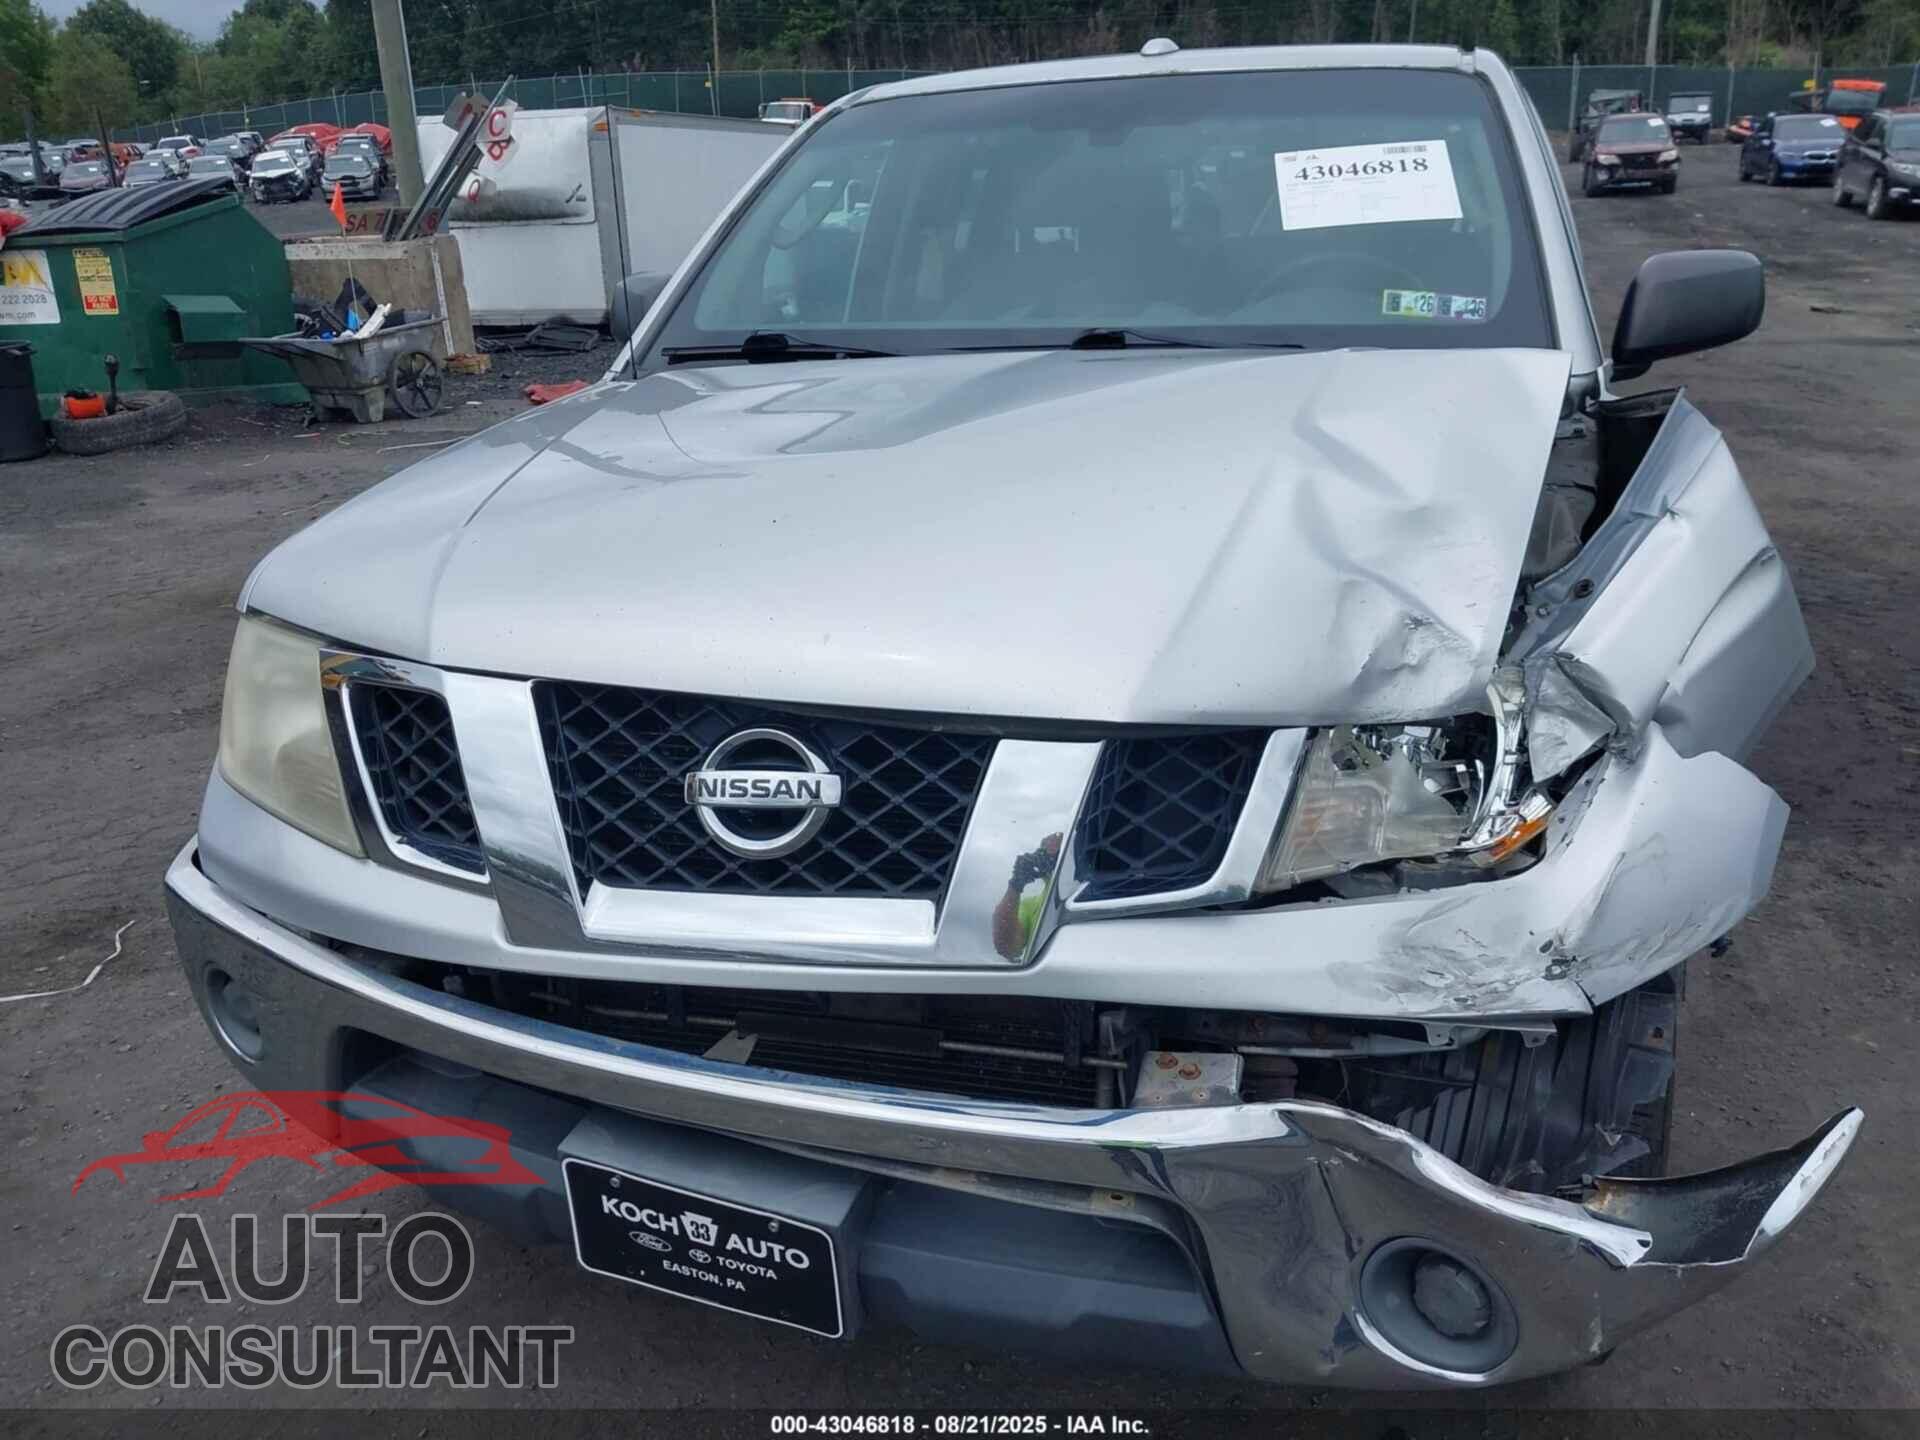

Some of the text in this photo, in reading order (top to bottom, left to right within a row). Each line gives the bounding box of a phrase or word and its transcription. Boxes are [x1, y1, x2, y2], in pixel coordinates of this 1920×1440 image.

[1294, 157, 1429, 181] 43046818
[697, 778, 821, 800] NISSAN
[601, 1195, 810, 1270] KOCH 33 AUTO
[634, 1233, 668, 1251] Ford
[663, 1260, 746, 1292] EASTON, PA
[716, 1256, 778, 1280] TOYOTA
